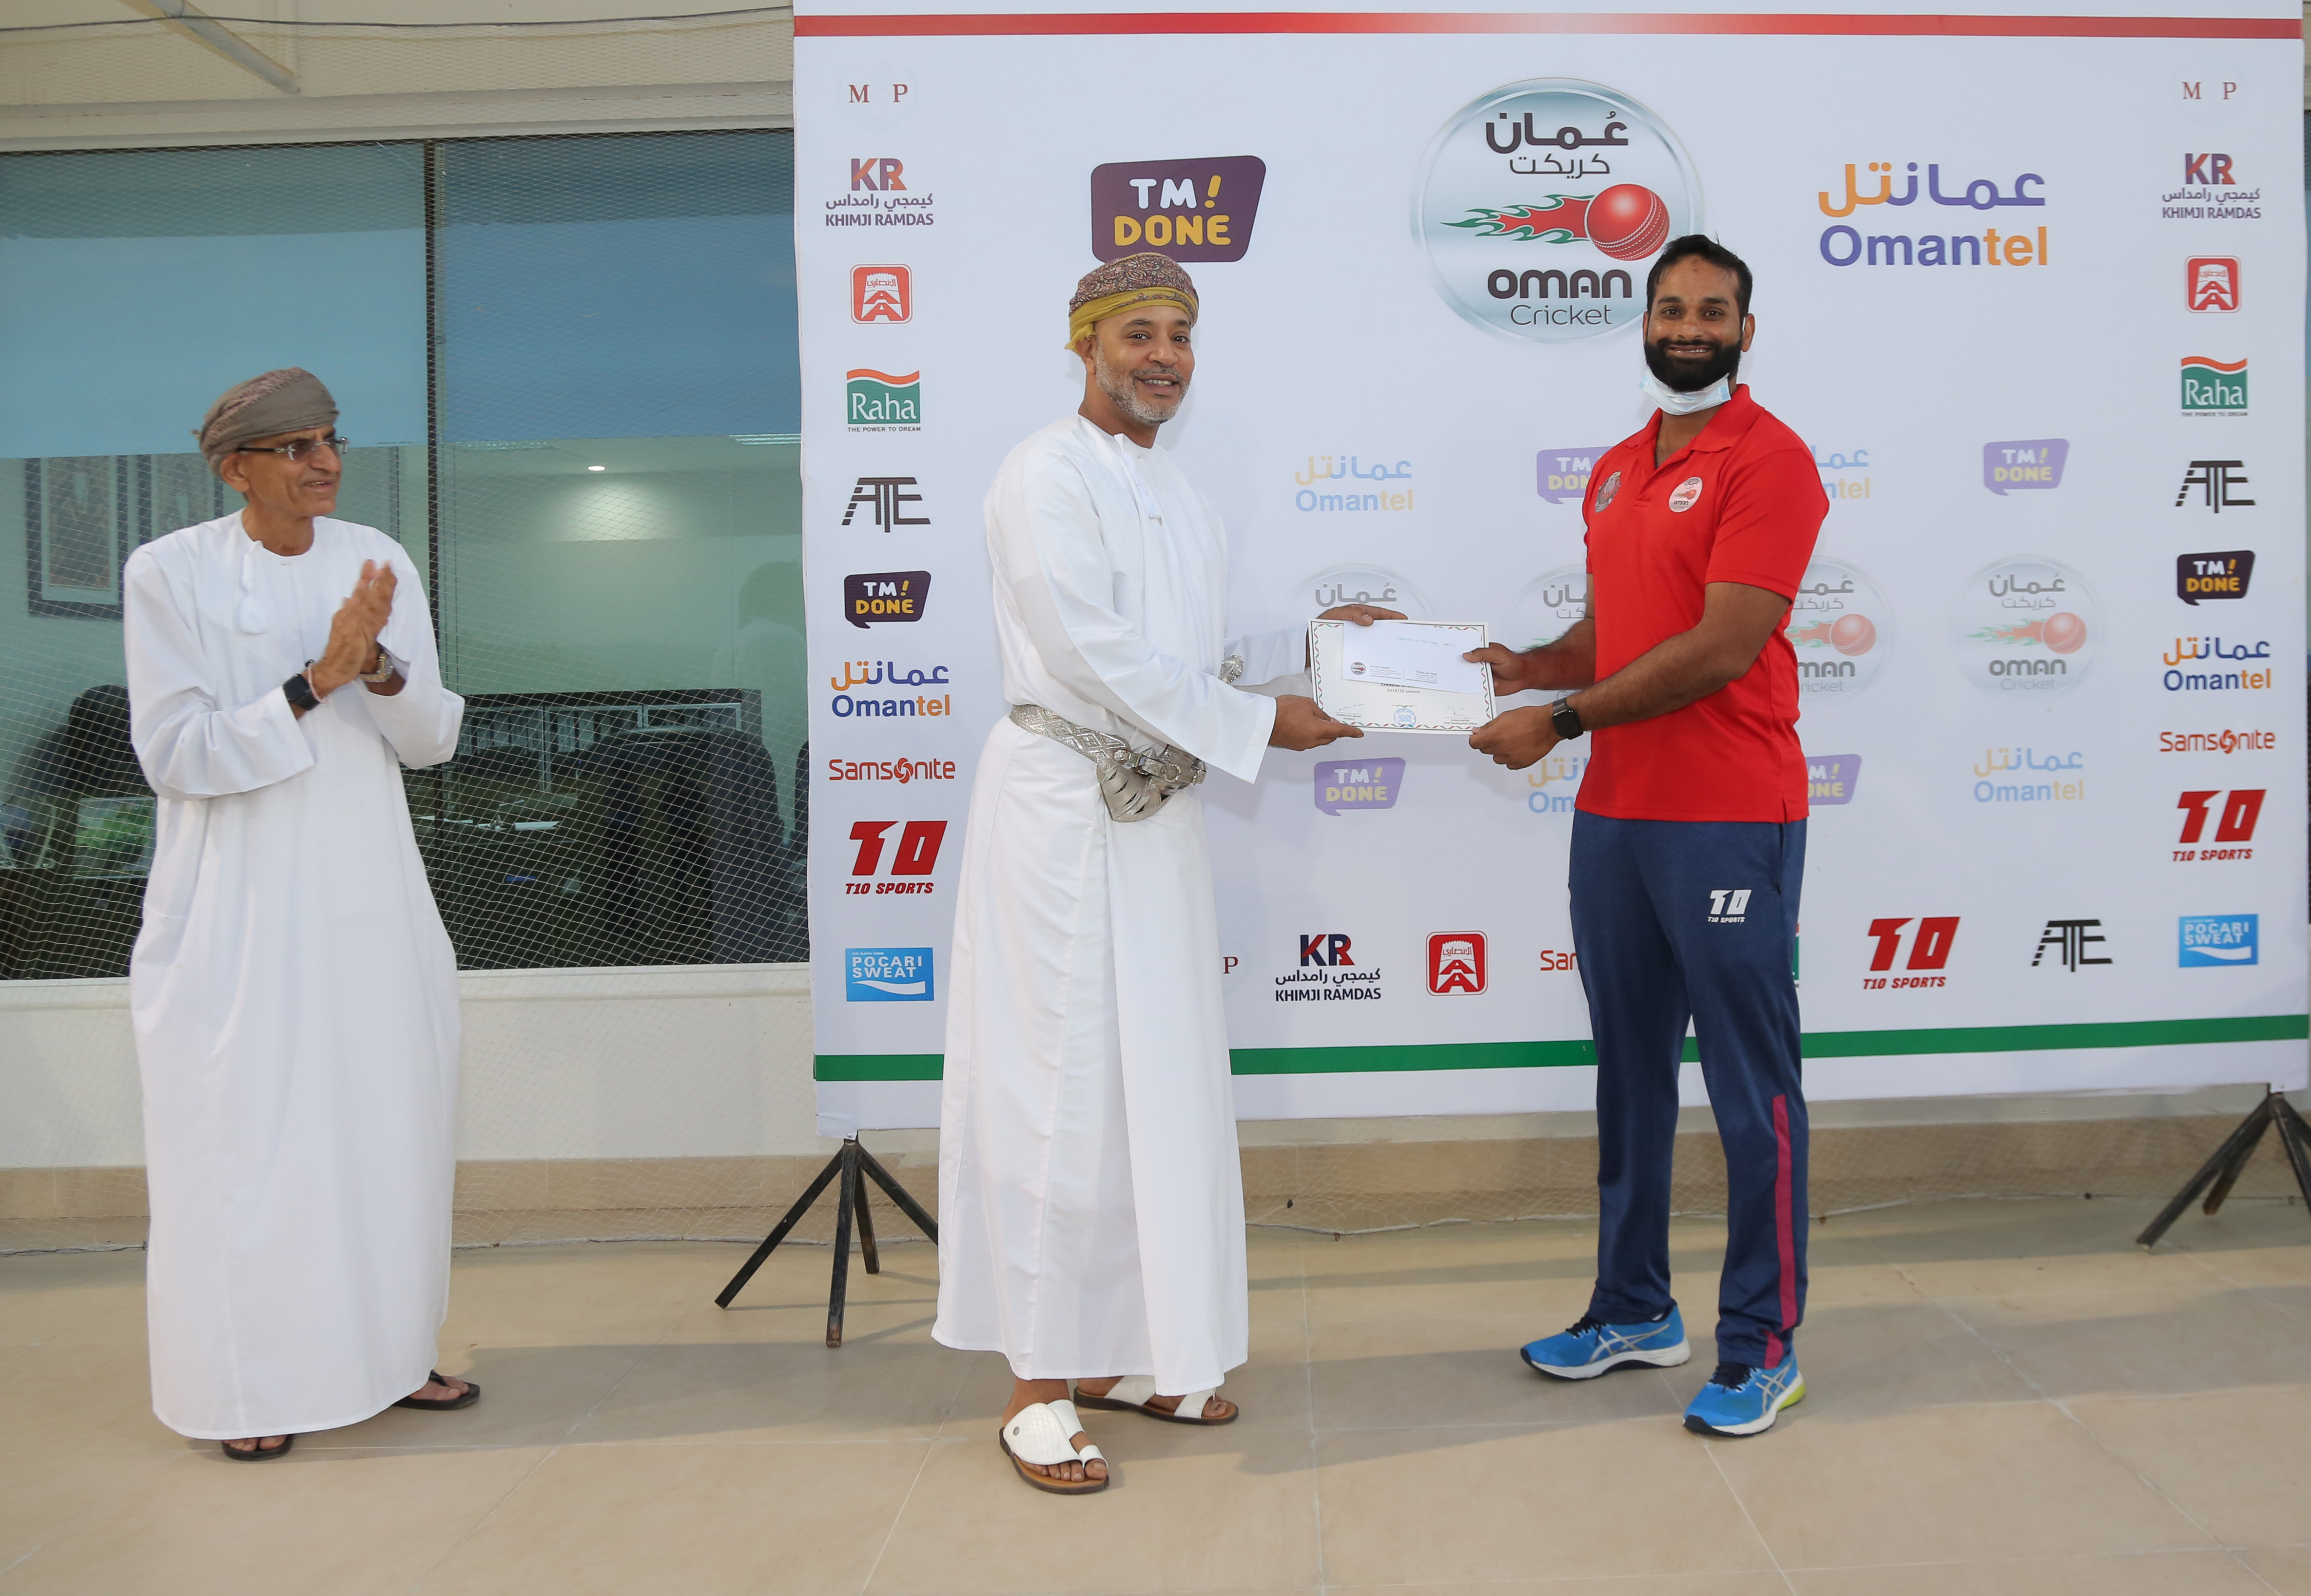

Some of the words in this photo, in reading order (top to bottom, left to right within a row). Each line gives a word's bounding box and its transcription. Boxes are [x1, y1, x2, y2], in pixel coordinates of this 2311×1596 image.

[849, 85, 869, 102] M
[893, 84, 908, 102] P
[2183, 82, 2201, 99] M
[2223, 82, 2236, 99] P
[851, 158, 907, 191] KR
[2185, 154, 2236, 185] KR
[826, 214, 871, 226] KHIMJI
[875, 214, 933, 226] RAMDAS
[2163, 207, 2204, 218] KHIMJI
[2208, 207, 2261, 218] RAMDAS
[1115, 215, 1230, 246] DONE
[1820, 225, 2047, 266] Omantel
[1511, 305, 1612, 325] Cricket
[2185, 379, 2244, 405] Raha
[852, 393, 916, 420] Raha
[1994, 467, 2053, 482] DONE
[1296, 489, 1412, 511] Omantel
[2187, 577, 2240, 592] DONE
[856, 599, 913, 614] DONE
[1801, 681, 1845, 692] ricket
[2001, 678, 2055, 690] Cricket
[2164, 669, 2271, 691] Omantel
[832, 695, 950, 717] Omantel
[2160, 730, 2274, 754] Samsonite
[829, 758, 955, 783] Samsonite
[1326, 786, 1387, 802] DONE
[1974, 780, 2083, 802] Omantel
[2174, 851, 2195, 861] T10
[2200, 849, 2253, 860] SPORTS
[846, 883, 871, 894] T10
[876, 882, 933, 894] SPORTS
[2185, 922, 2249, 934] POCARI
[2185, 933, 2243, 945] SWEAT
[1300, 934, 1355, 966] KR
[853, 956, 922, 967] POCARI
[853, 967, 916, 978] SWEAT
[1864, 978, 1886, 989] T10
[1892, 977, 1945, 988] SPORTS
[1276, 990, 1320, 1001] KHIMJI
[1324, 988, 1381, 1000] RAMDAS
